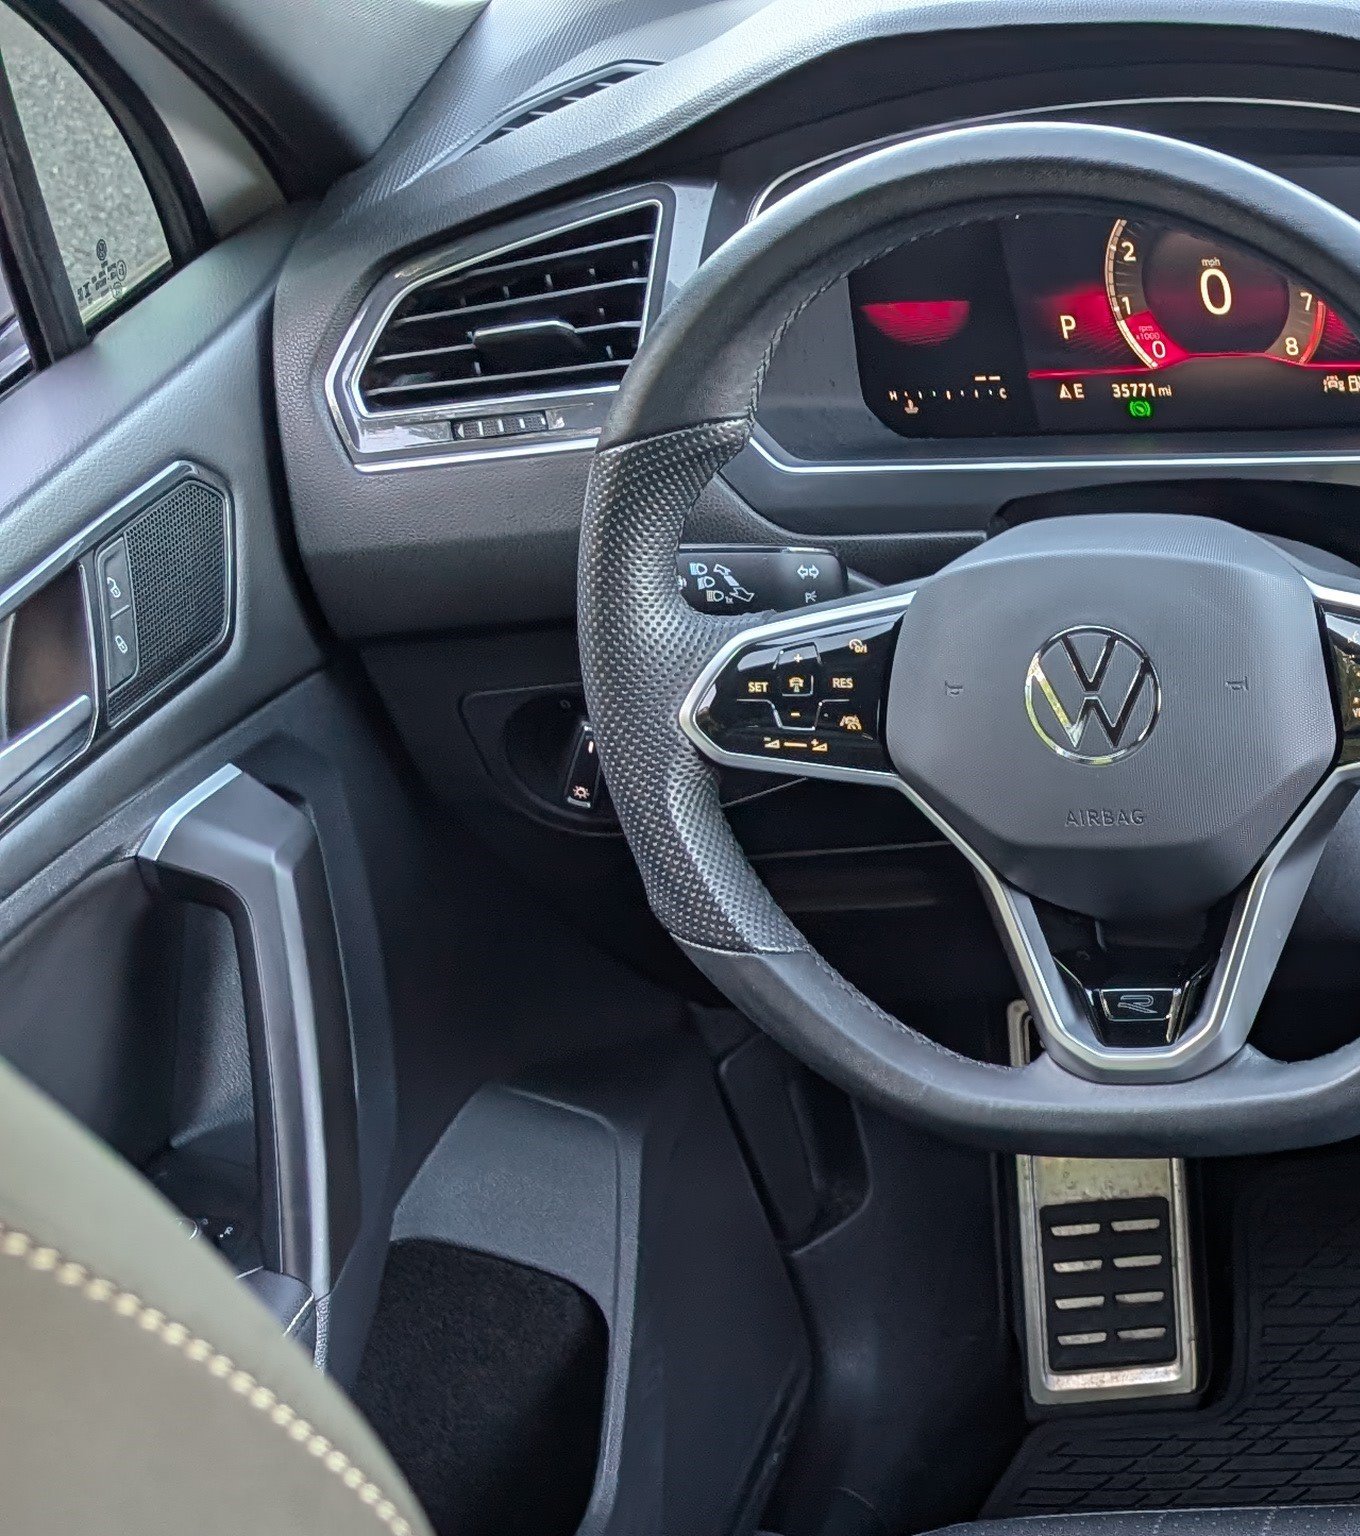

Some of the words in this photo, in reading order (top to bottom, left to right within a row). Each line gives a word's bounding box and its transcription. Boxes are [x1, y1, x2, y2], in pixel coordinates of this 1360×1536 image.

[1121, 241, 1136, 262] 2
[1201, 257, 1221, 268] mph
[1199, 267, 1232, 316] 0
[1300, 291, 1313, 311] 7
[1121, 296, 1132, 315] 1
[1059, 315, 1076, 340] P
[1151, 340, 1167, 359] 0
[1284, 337, 1299, 356] 8
[1111, 383, 1156, 399] 35771
[748, 681, 769, 693] SET
[832, 677, 854, 689] RES
[1064, 808, 1145, 827] AIRBAG
